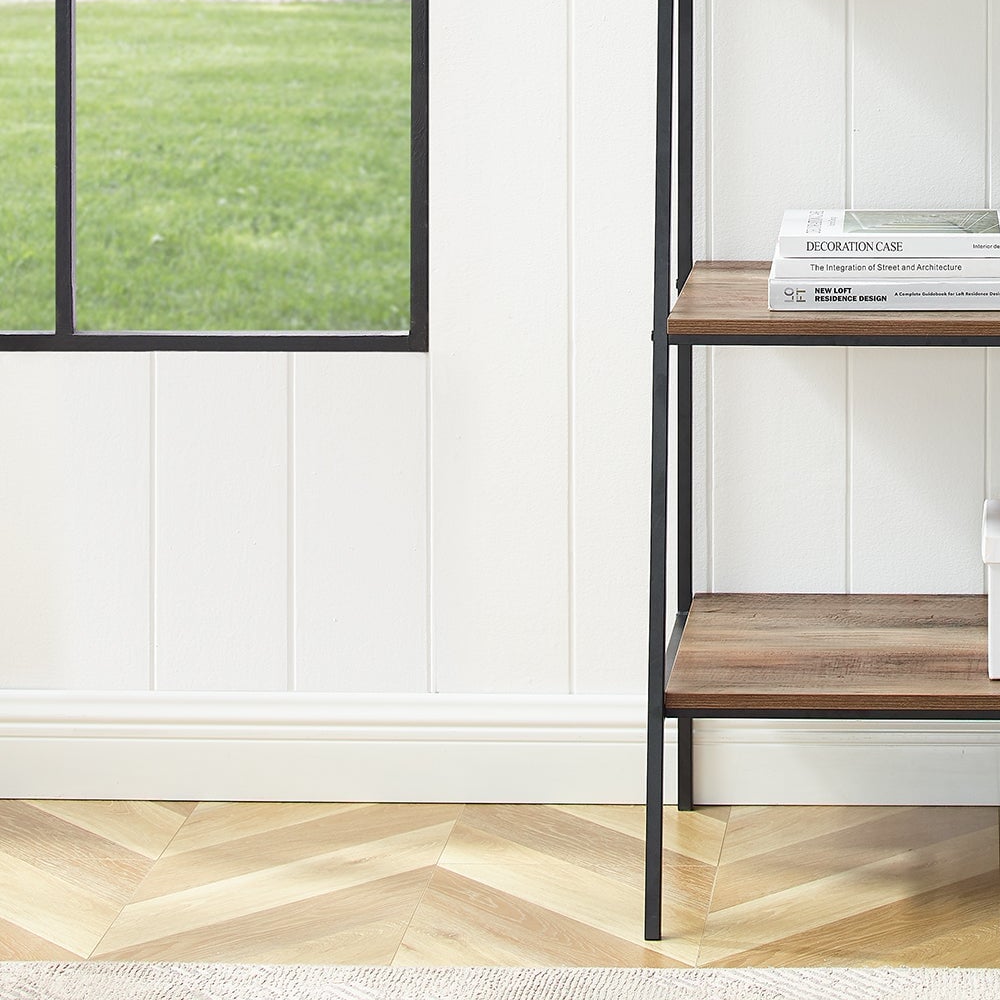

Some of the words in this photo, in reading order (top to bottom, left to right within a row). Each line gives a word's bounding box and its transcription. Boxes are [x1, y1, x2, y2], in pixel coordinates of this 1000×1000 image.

[806, 241, 874, 251] DECORATION
[875, 241, 903, 251] CASE
[810, 263, 825, 271] The
[826, 263, 867, 273] Integration
[868, 263, 876, 271] of
[877, 263, 900, 271] Street
[901, 263, 916, 271] and
[917, 263, 962, 271] Architecture
